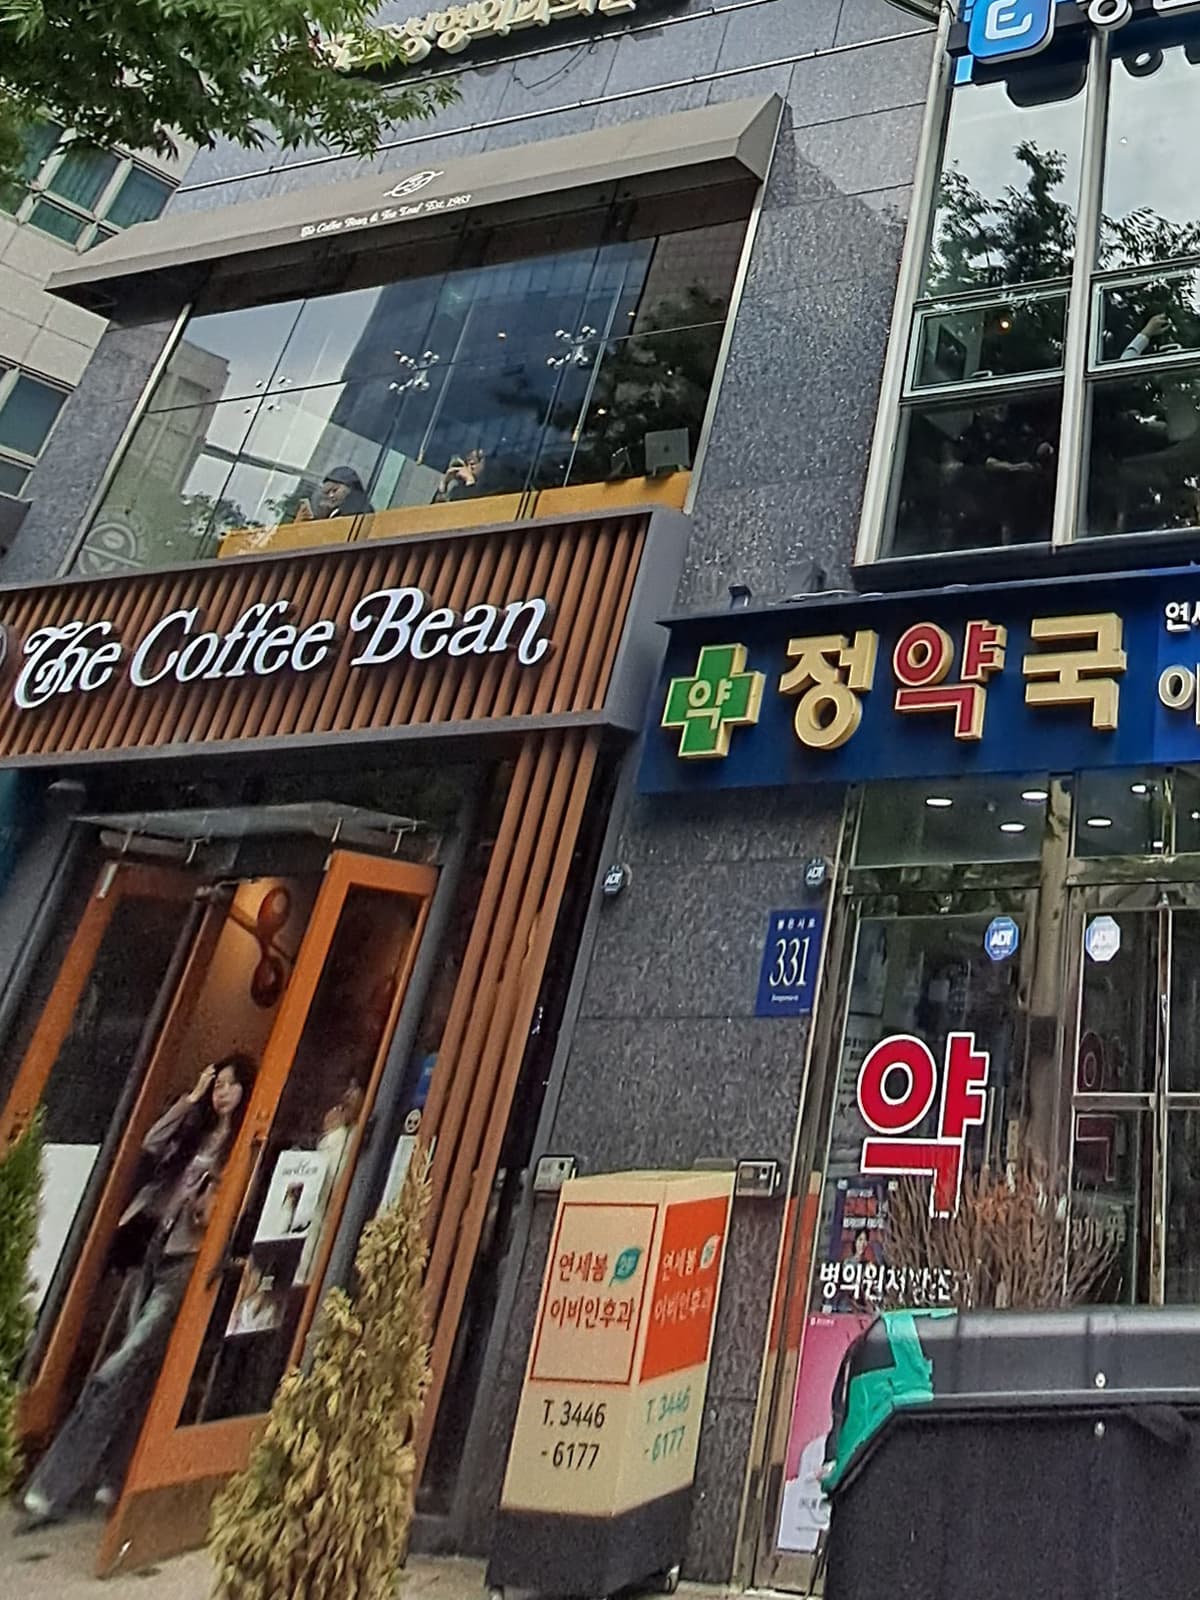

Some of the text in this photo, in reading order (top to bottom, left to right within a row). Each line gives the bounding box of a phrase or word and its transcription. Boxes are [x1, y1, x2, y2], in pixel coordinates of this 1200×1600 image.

[14, 586, 552, 710] The Coffee Bean
[685, 676, 733, 733] 약
[778, 611, 1129, 750] 정약국
[768, 935, 811, 987] 331
[857, 1032, 990, 1219] 약
[558, 1250, 609, 1283] 연세봄
[550, 1295, 635, 1332] 이비인후과
[558, 1400, 608, 1429] 3446
